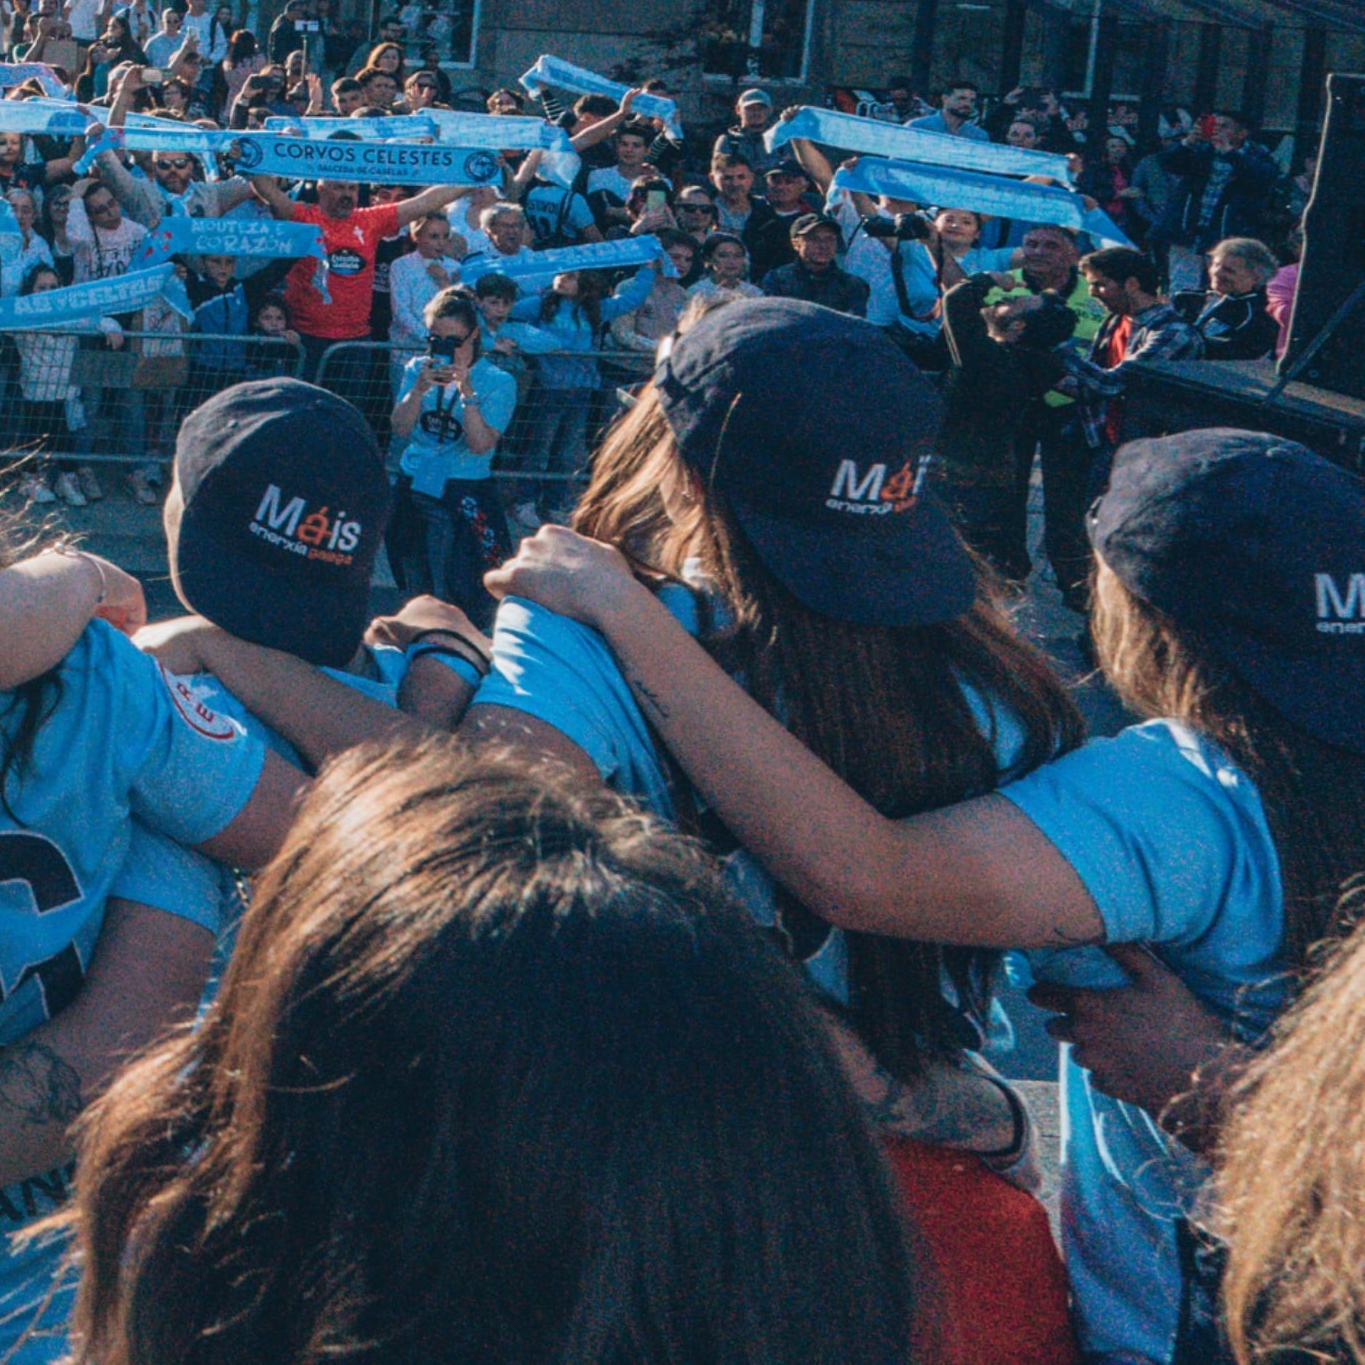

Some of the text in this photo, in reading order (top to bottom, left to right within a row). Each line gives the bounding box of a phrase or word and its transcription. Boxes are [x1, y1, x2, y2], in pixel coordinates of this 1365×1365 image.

[273, 142, 453, 167] CORVOS CELESTES
[72, 273, 164, 308] CELTAS
[254, 483, 363, 552] Máis
